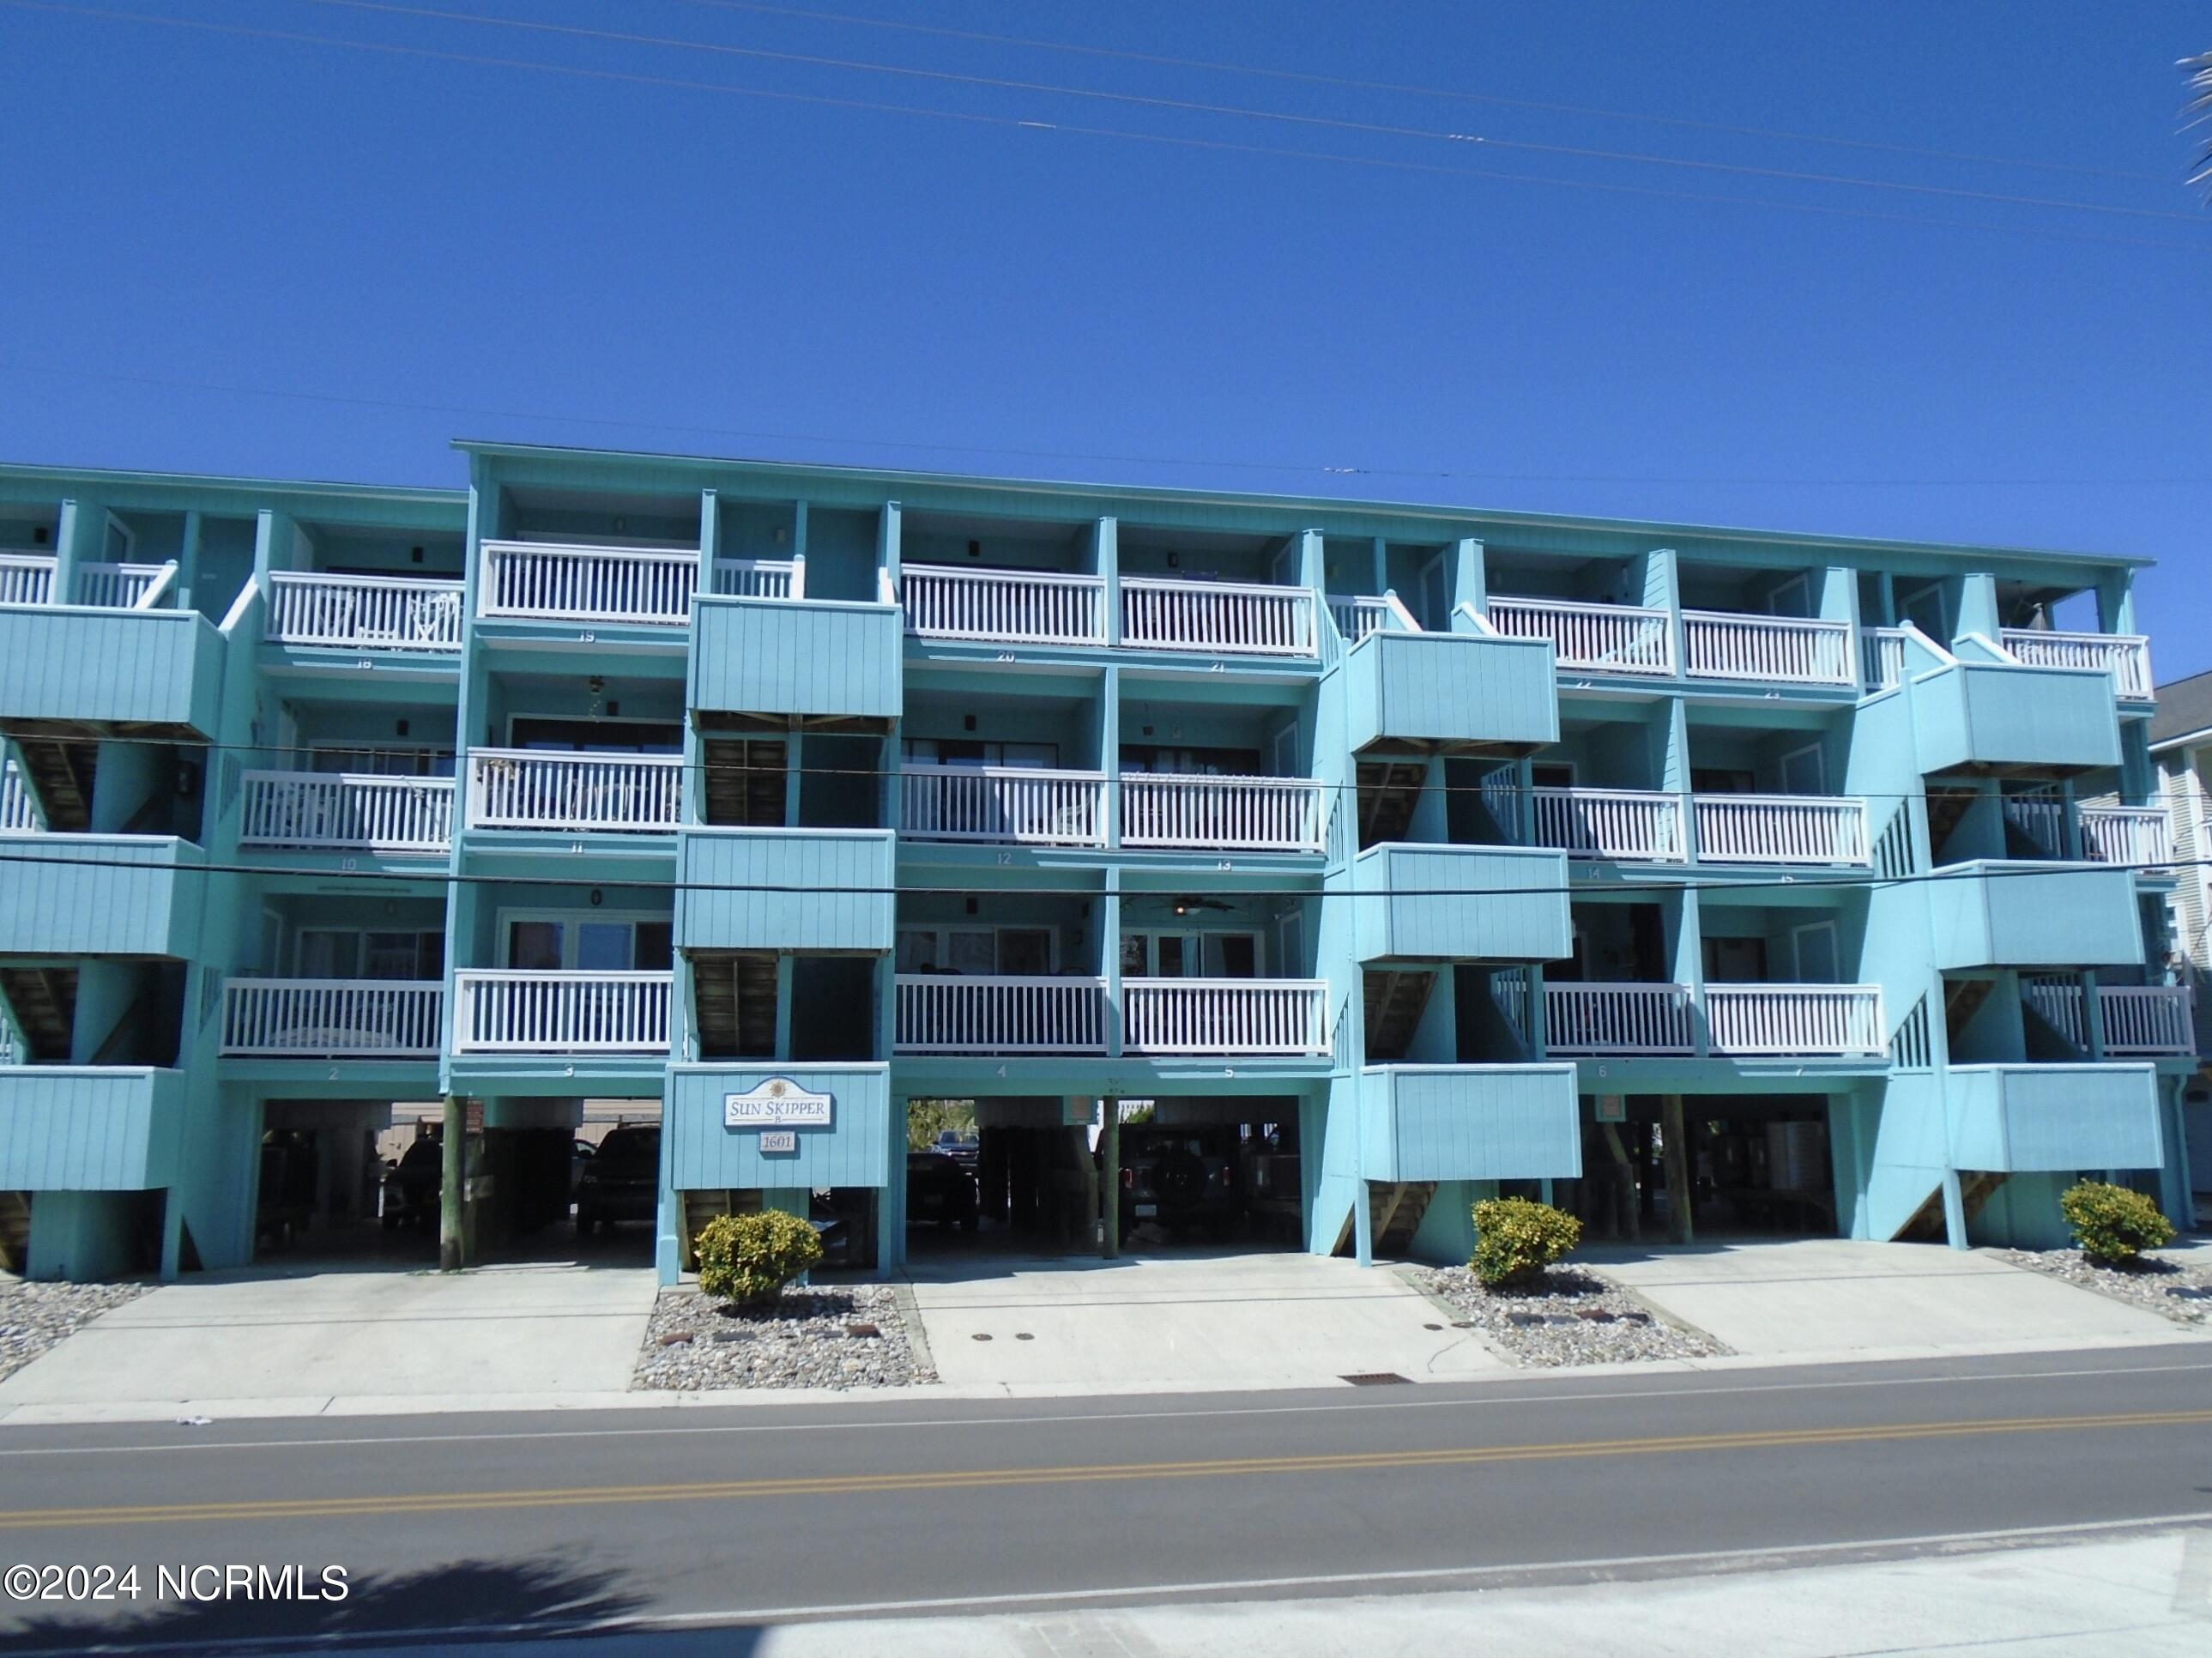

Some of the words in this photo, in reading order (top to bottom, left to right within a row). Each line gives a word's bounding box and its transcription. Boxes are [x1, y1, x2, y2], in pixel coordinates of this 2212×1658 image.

[996, 650, 1014, 662] 20
[357, 657, 372, 669] 18
[1211, 661, 1224, 672] 21
[571, 841, 583, 853] 11
[341, 858, 356, 870] 10
[998, 851, 1011, 865] 12
[1218, 859, 1230, 870] 13
[1588, 867, 1600, 879] 14
[1781, 873, 1793, 883] 15
[329, 1068, 338, 1080] 2
[565, 1063, 573, 1076] 3
[997, 1064, 1006, 1078] 4
[1224, 1065, 1234, 1078] 5
[1599, 1064, 1606, 1077] 6
[730, 1101, 761, 1116] SUN
[765, 1101, 825, 1115] SKIPPER
[764, 1135, 790, 1148] 1601
